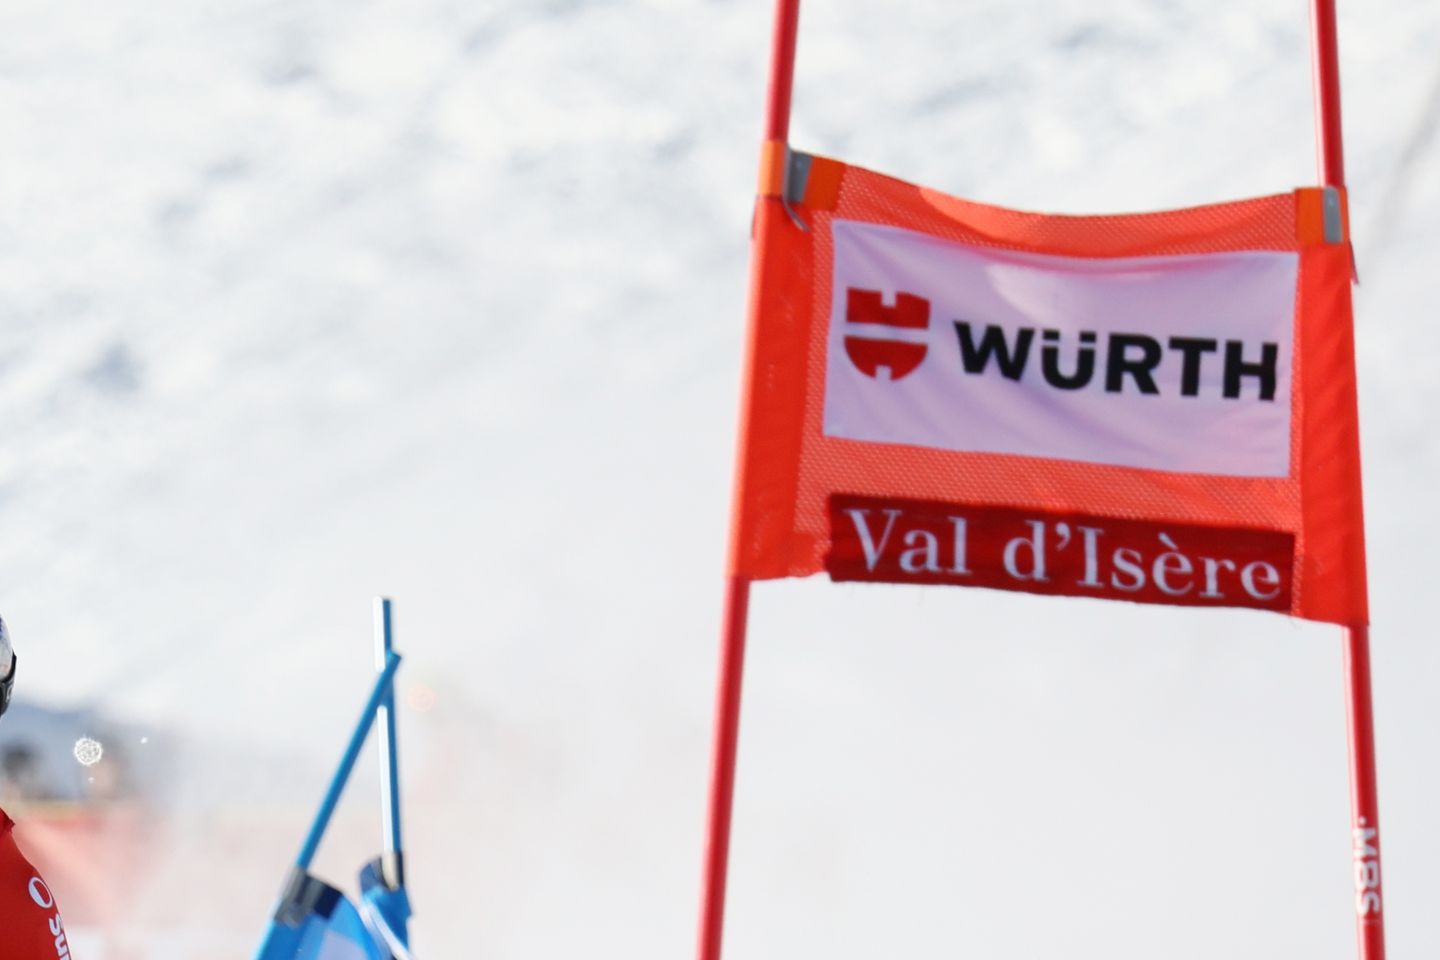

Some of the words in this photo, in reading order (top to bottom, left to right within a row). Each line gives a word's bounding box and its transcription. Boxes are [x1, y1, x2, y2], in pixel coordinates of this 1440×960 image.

[953, 319, 1279, 402] WÜRTH
[843, 508, 973, 576] Val
[1002, 516, 1282, 602] d'Isère
